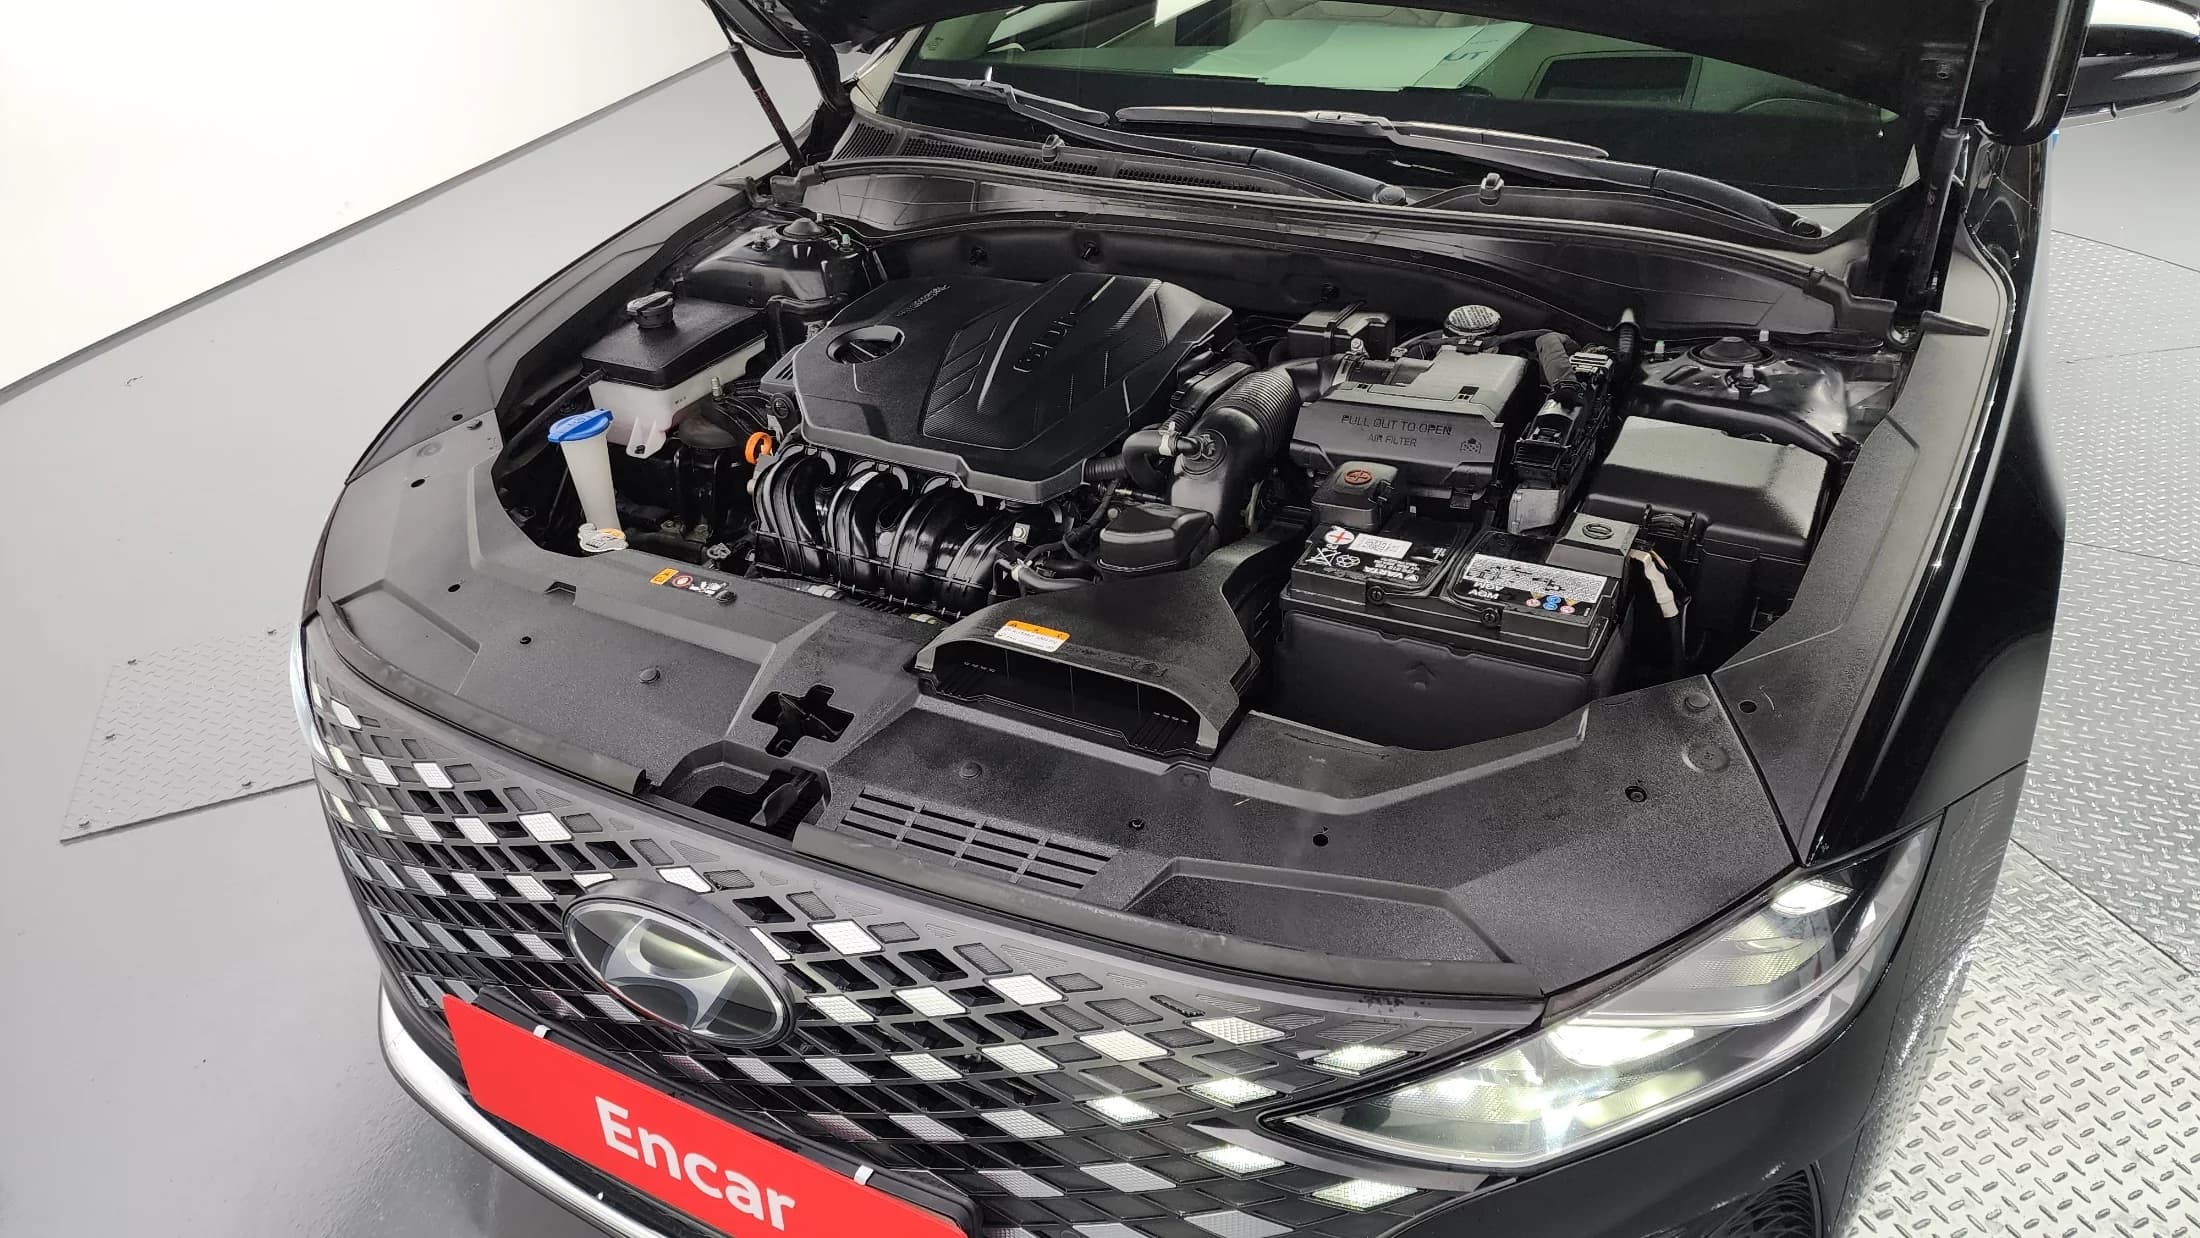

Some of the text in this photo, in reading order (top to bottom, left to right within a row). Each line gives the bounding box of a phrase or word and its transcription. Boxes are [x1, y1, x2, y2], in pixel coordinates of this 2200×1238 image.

[1340, 414, 1452, 436] PULL OUT TO OPEN
[1367, 433, 1417, 448] AIR FILTER
[1363, 566, 1404, 579] VARTA
[594, 1095, 797, 1232] Encar
